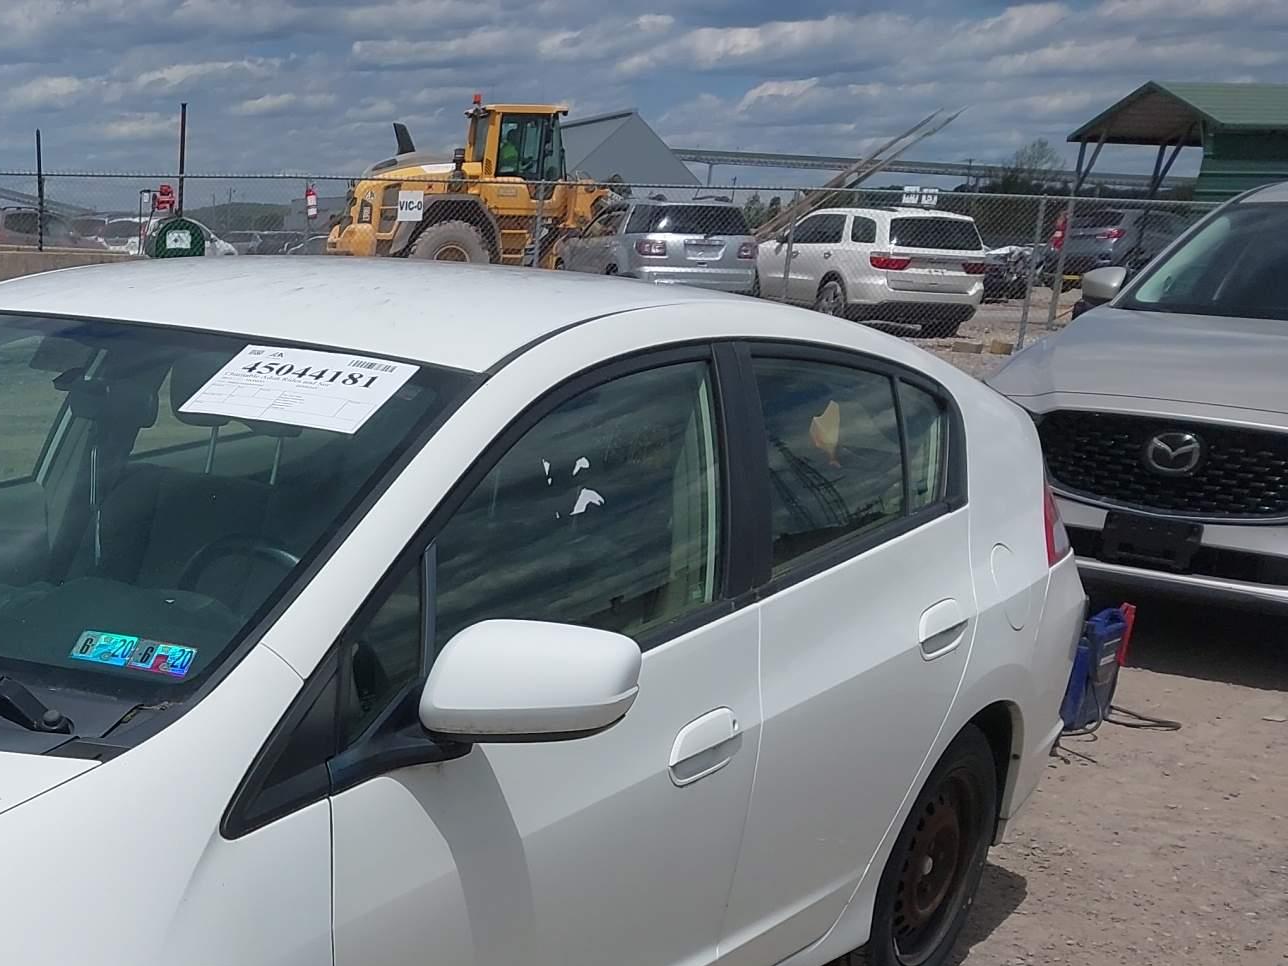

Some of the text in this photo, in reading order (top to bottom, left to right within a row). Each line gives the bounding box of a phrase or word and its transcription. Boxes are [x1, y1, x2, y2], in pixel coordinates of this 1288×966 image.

[242, 360, 379, 389] 45044181
[80, 638, 134, 659] 6 20
[171, 649, 193, 670] 20
